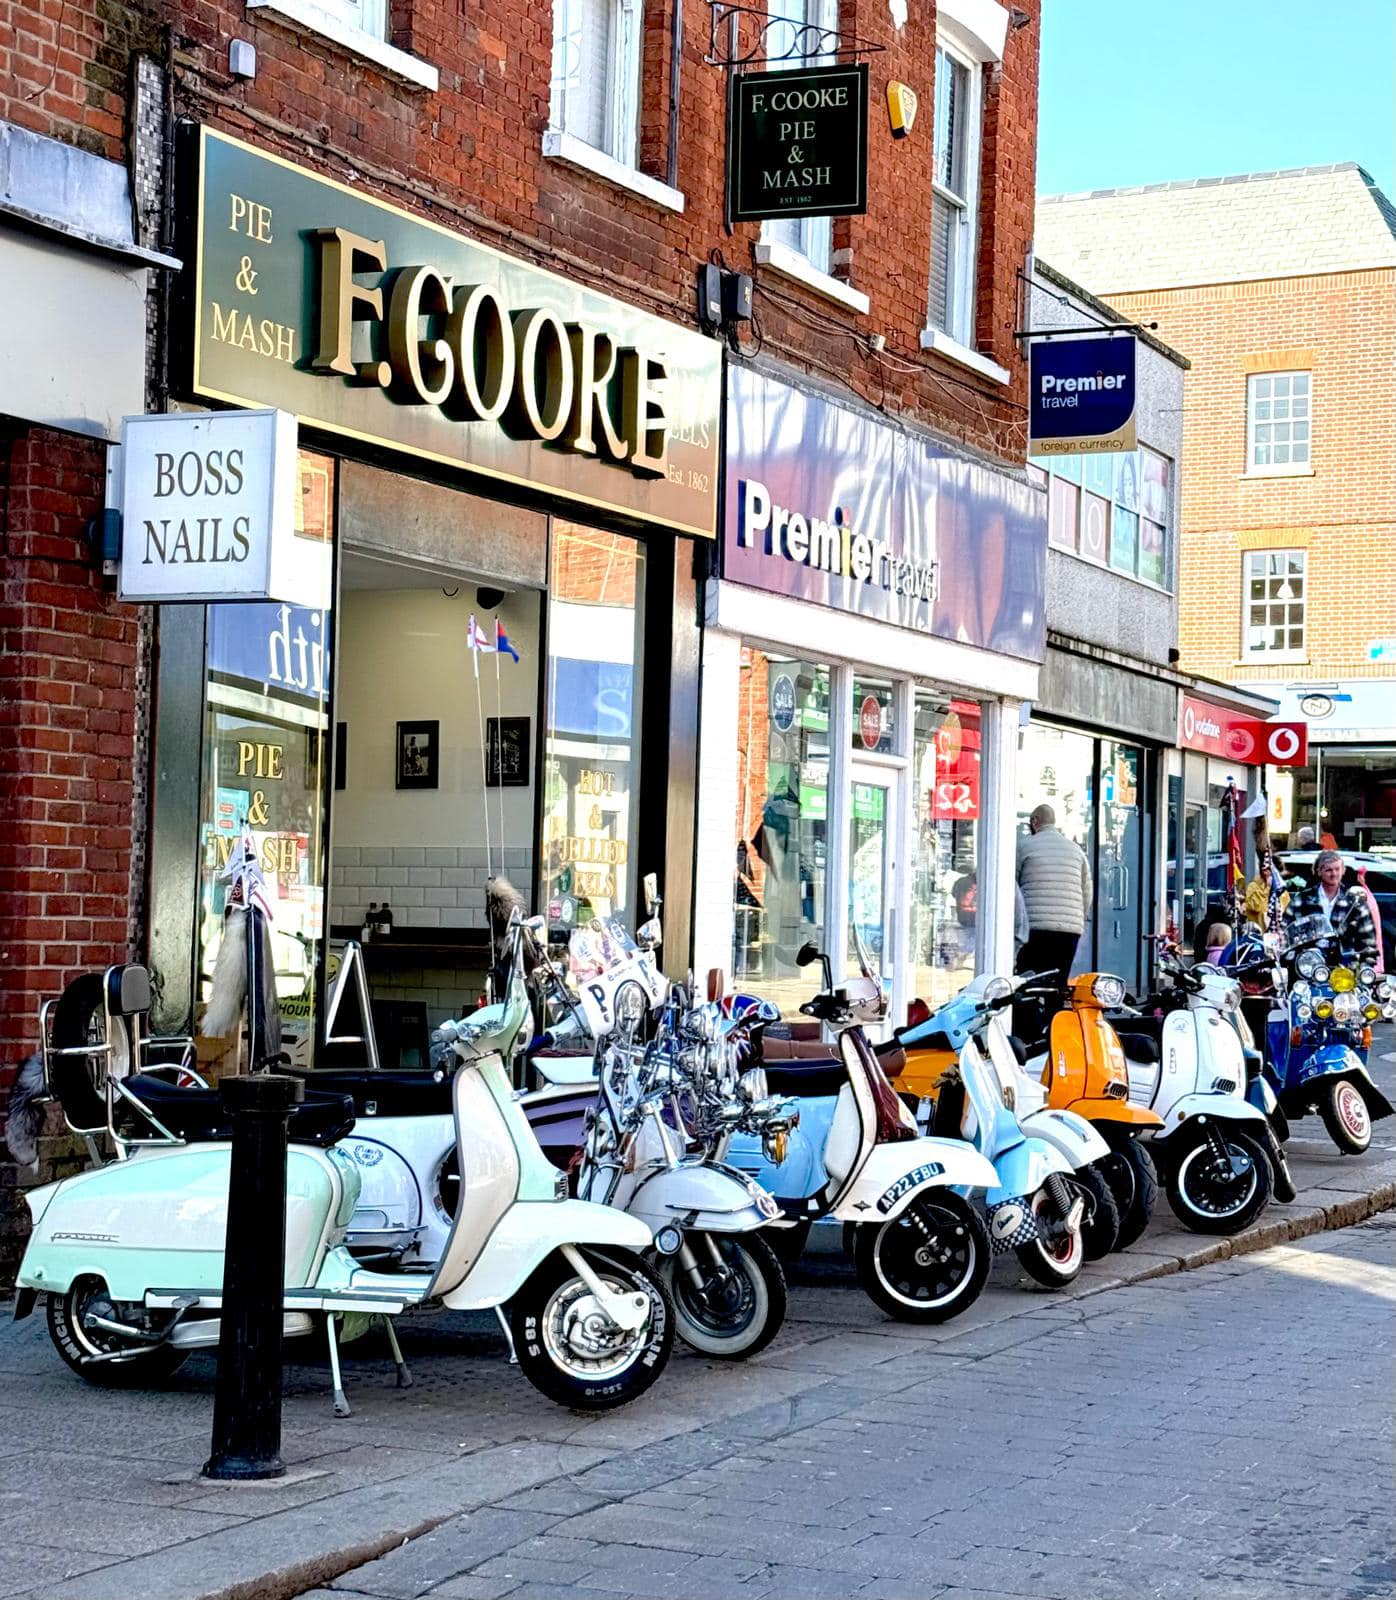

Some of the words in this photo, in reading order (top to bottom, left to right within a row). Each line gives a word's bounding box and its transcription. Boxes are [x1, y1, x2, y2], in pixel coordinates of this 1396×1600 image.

[779, 121, 816, 141] PIE
[788, 145, 804, 163] &
[762, 166, 831, 189] MASH
[228, 193, 273, 244] PIE
[236, 256, 258, 295] &
[211, 302, 295, 364] MASH
[1041, 370, 1126, 393] Premier
[1041, 393, 1078, 408] travel
[1041, 440, 1076, 452] foreign
[1079, 439, 1125, 449] currency
[153, 449, 243, 497] BOSS
[688, 470, 708, 493] 1862
[142, 516, 250, 564] NAILS
[740, 478, 891, 586] Premier
[237, 741, 284, 779] PIE
[578, 768, 615, 796] HOT
[248, 789, 270, 825] &
[213, 835, 300, 873] MSH
[880, 1178, 912, 1209] AP22
[911, 1163, 940, 1183] FBU
